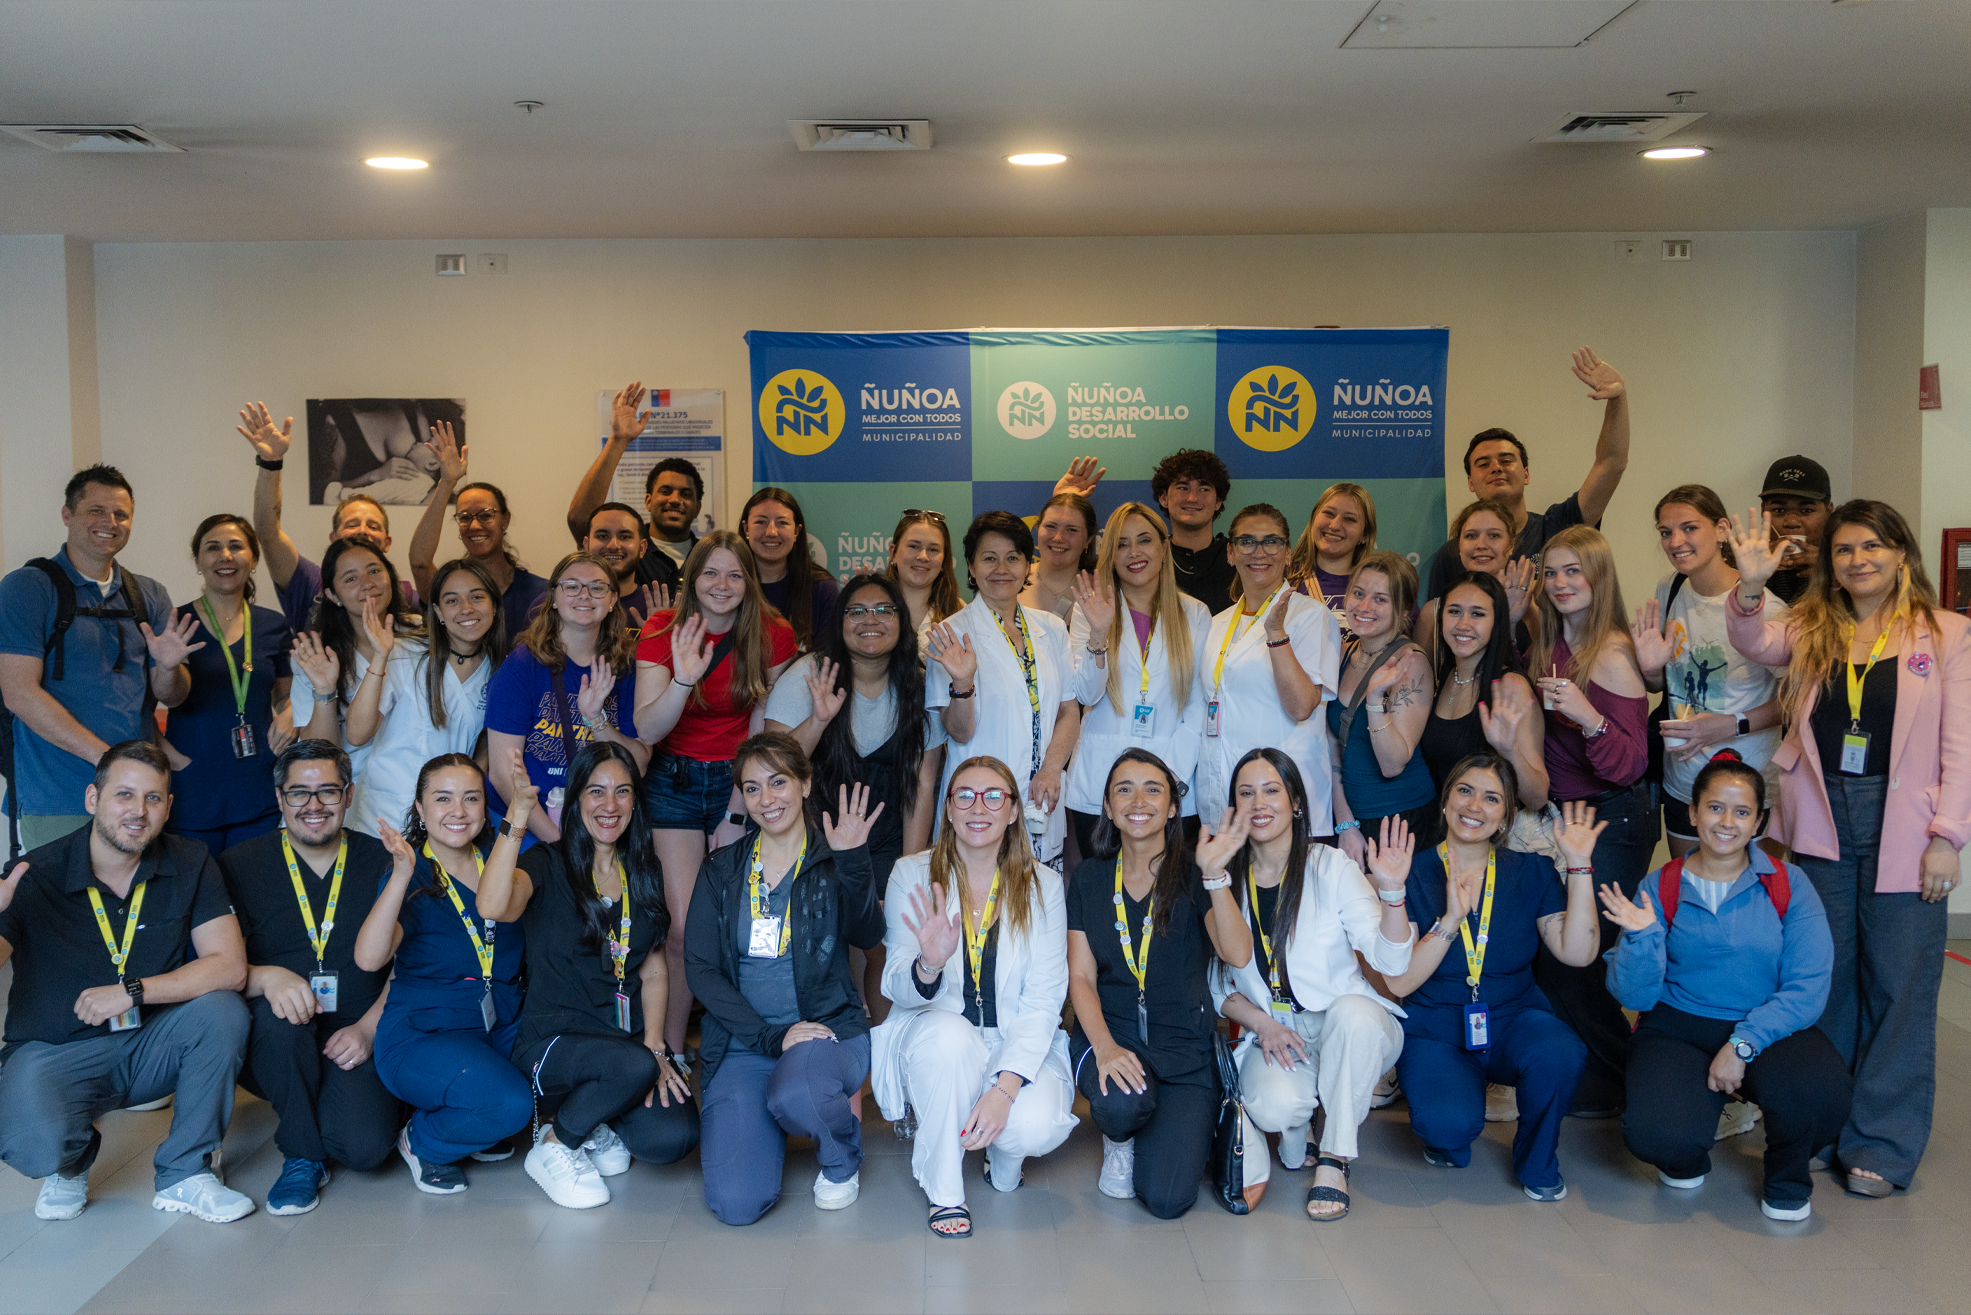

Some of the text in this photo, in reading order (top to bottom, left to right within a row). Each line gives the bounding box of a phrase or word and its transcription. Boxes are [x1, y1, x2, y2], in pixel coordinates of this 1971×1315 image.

[861, 383, 961, 410] ÑUÑOA
[1067, 382, 1147, 404] ÑUÑOA
[1333, 378, 1433, 406] ÑUÑOA
[862, 413, 961, 423] MEJOR CON TODOS
[1067, 405, 1189, 421] DESARROLLO
[1333, 410, 1432, 419] MEJOR CON TODOS
[862, 432, 962, 442] MUNICIPALIDAD
[1067, 424, 1137, 439] SOCIAL
[1332, 429, 1432, 438] MUNICIPALIDAD
